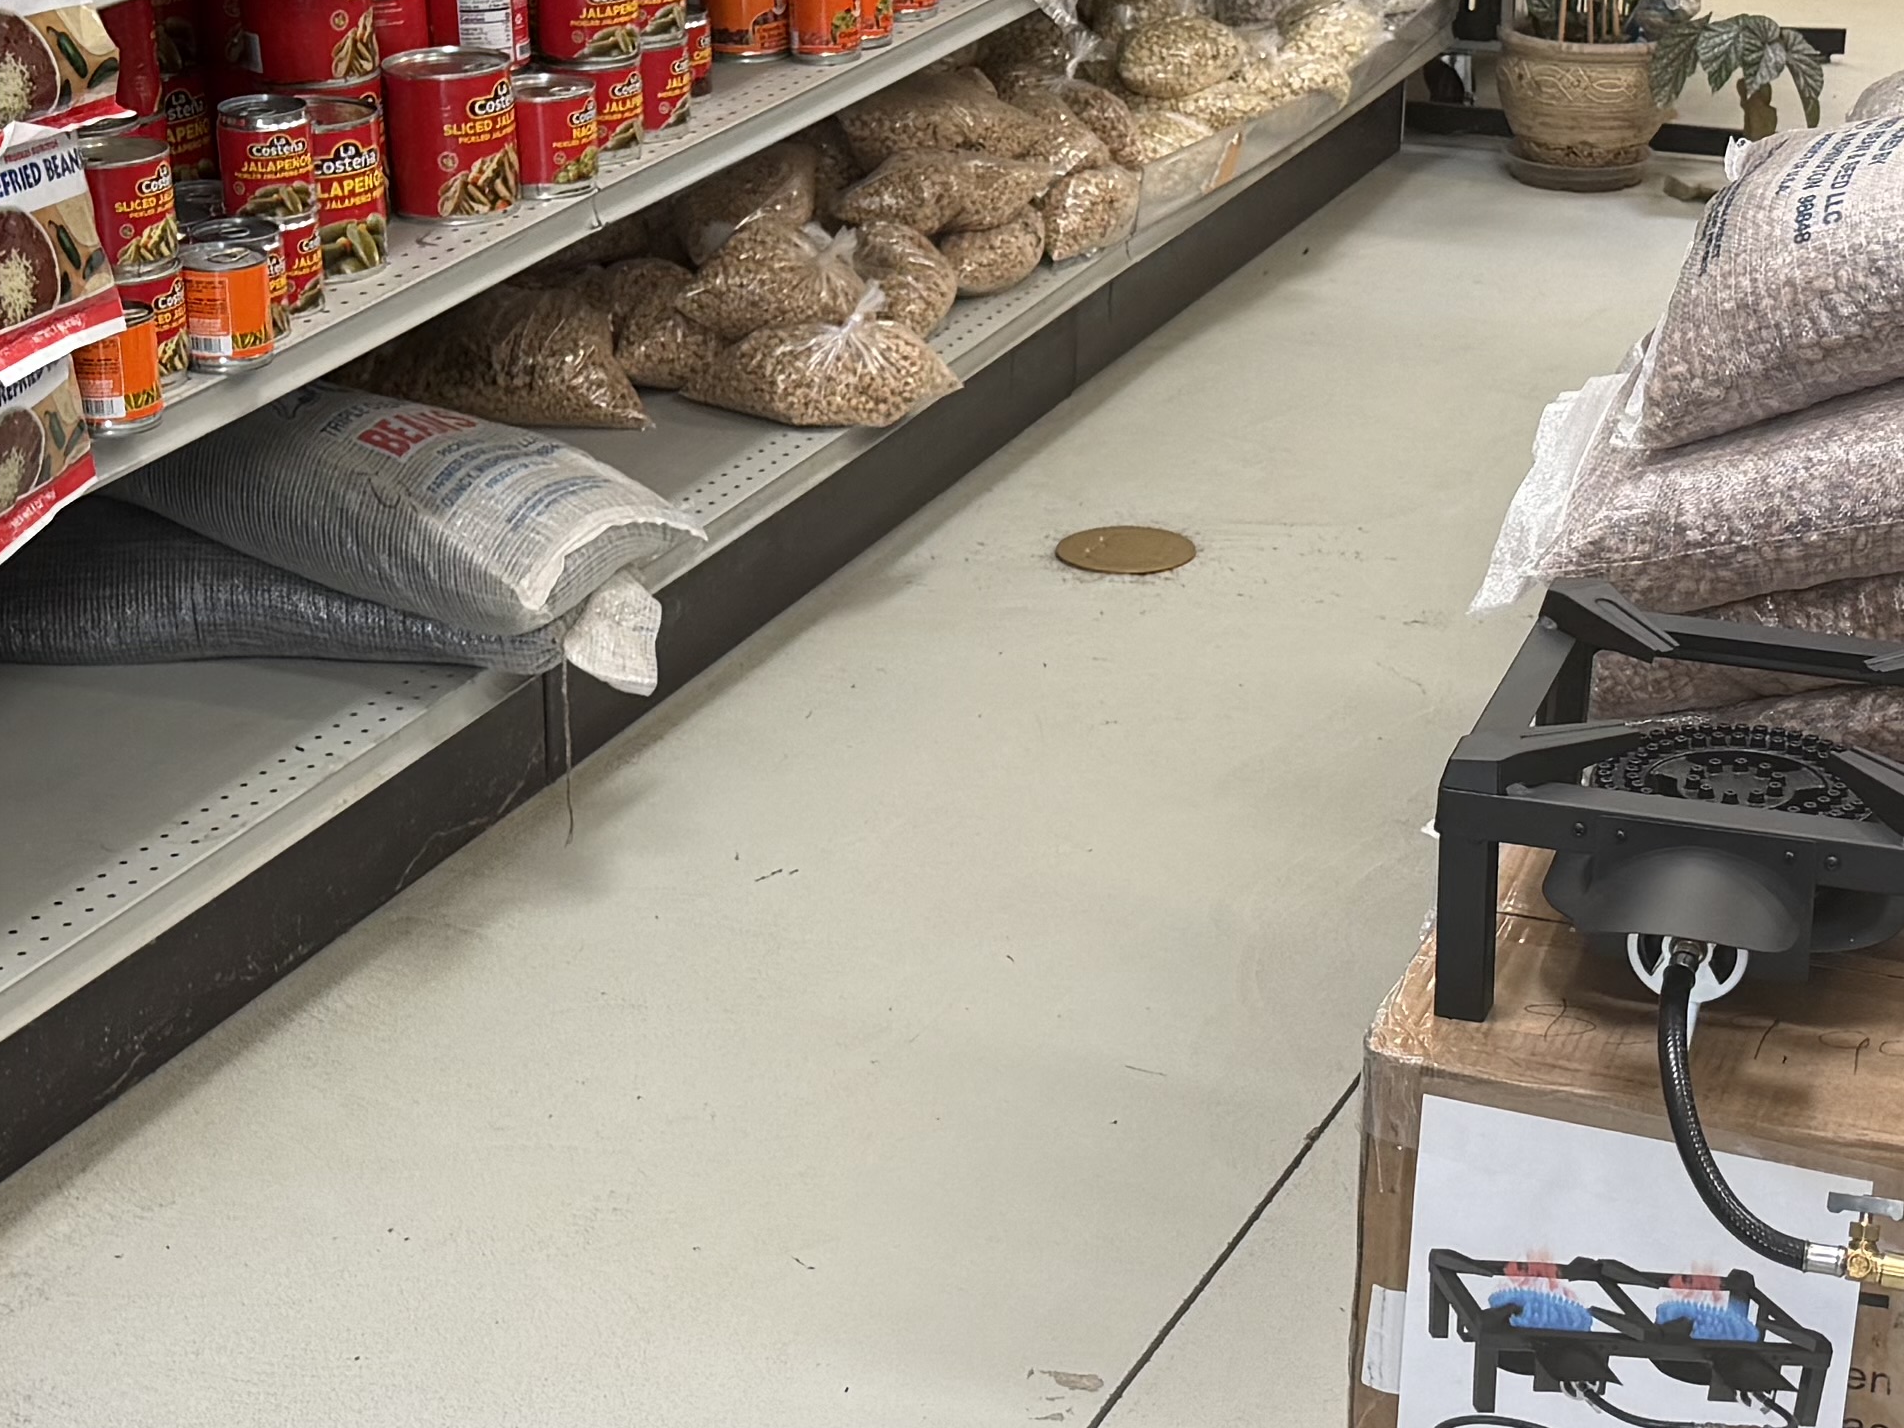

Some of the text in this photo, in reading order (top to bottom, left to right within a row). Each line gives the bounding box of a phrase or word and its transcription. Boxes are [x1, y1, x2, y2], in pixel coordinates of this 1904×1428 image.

[442, 118, 489, 139] SLICED
[1822, 191, 1845, 225] LLC
[357, 407, 477, 459] BEANS
